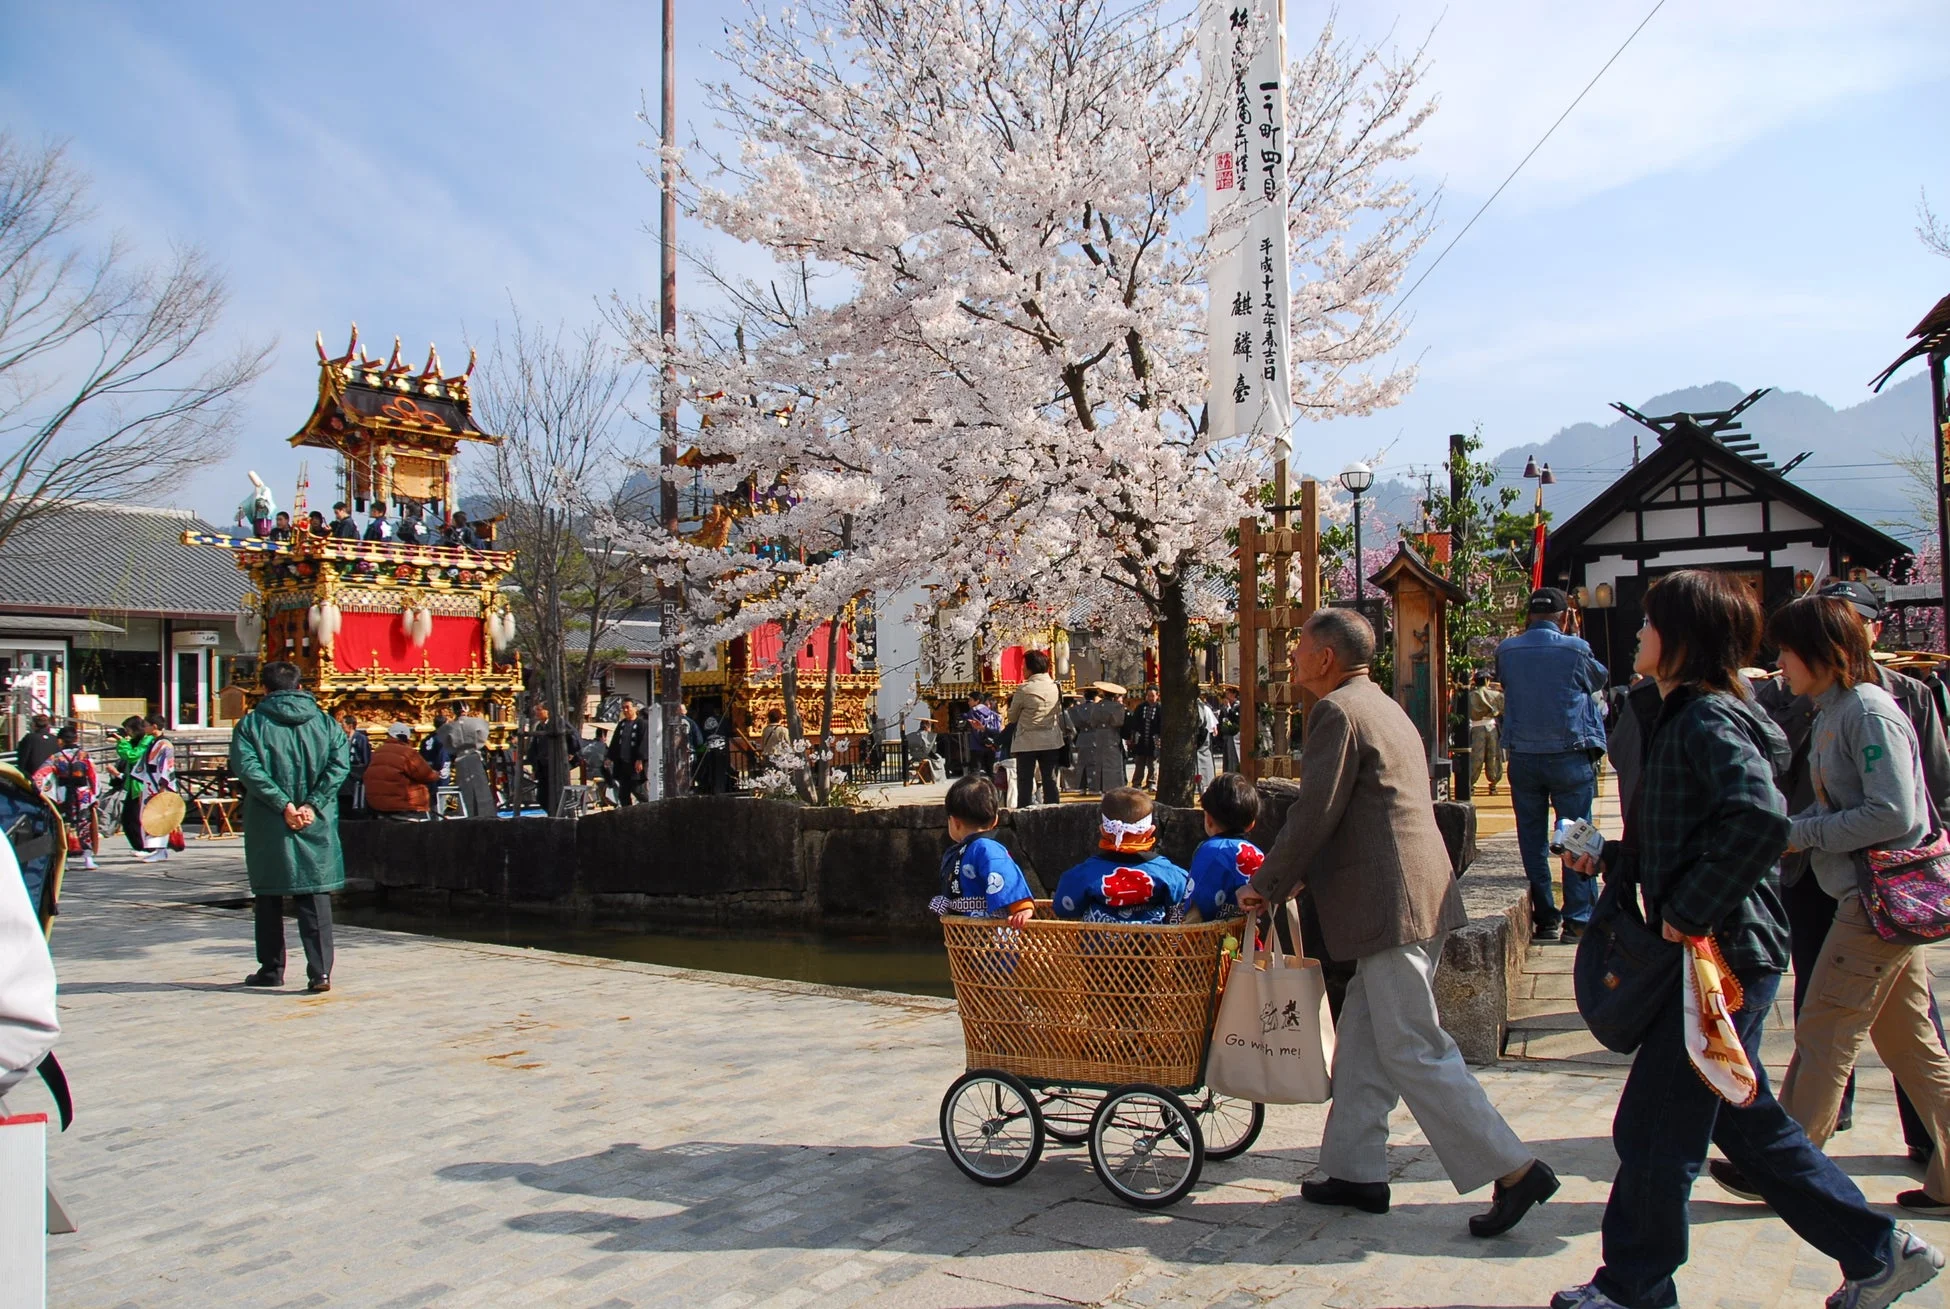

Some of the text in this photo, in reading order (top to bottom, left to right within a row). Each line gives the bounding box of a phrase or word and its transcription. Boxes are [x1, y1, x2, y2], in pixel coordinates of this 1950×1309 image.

[1259, 237, 1277, 382] 平成十五年春吉日
[664, 617, 675, 660] お手い
[1862, 744, 1883, 774] P
[1225, 1033, 1246, 1047] Go
[1280, 1047, 1301, 1060] me!
